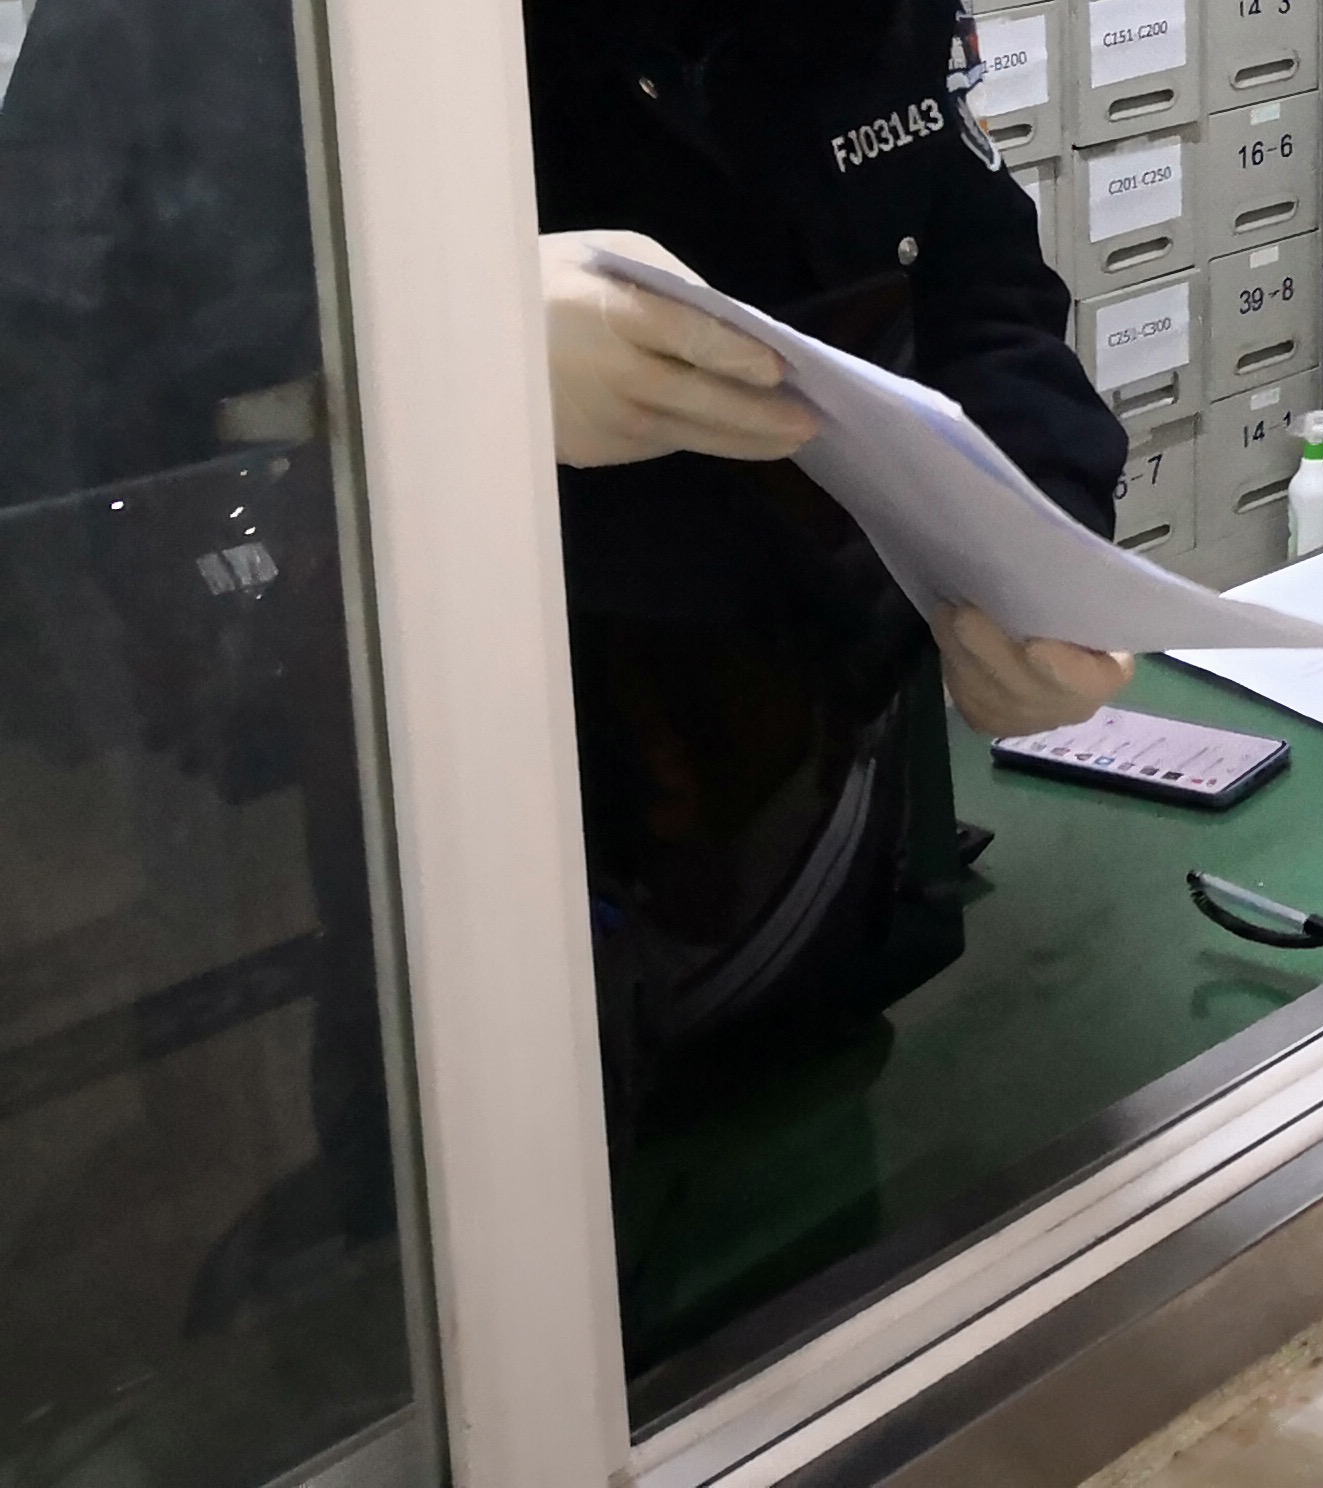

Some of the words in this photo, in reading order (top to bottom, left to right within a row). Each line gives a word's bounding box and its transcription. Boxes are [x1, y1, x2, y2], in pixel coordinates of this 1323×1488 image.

[830, 98, 945, 173] FJ03143
[1238, 134, 1294, 169] 16-6
[1239, 277, 1295, 314] 39-8
